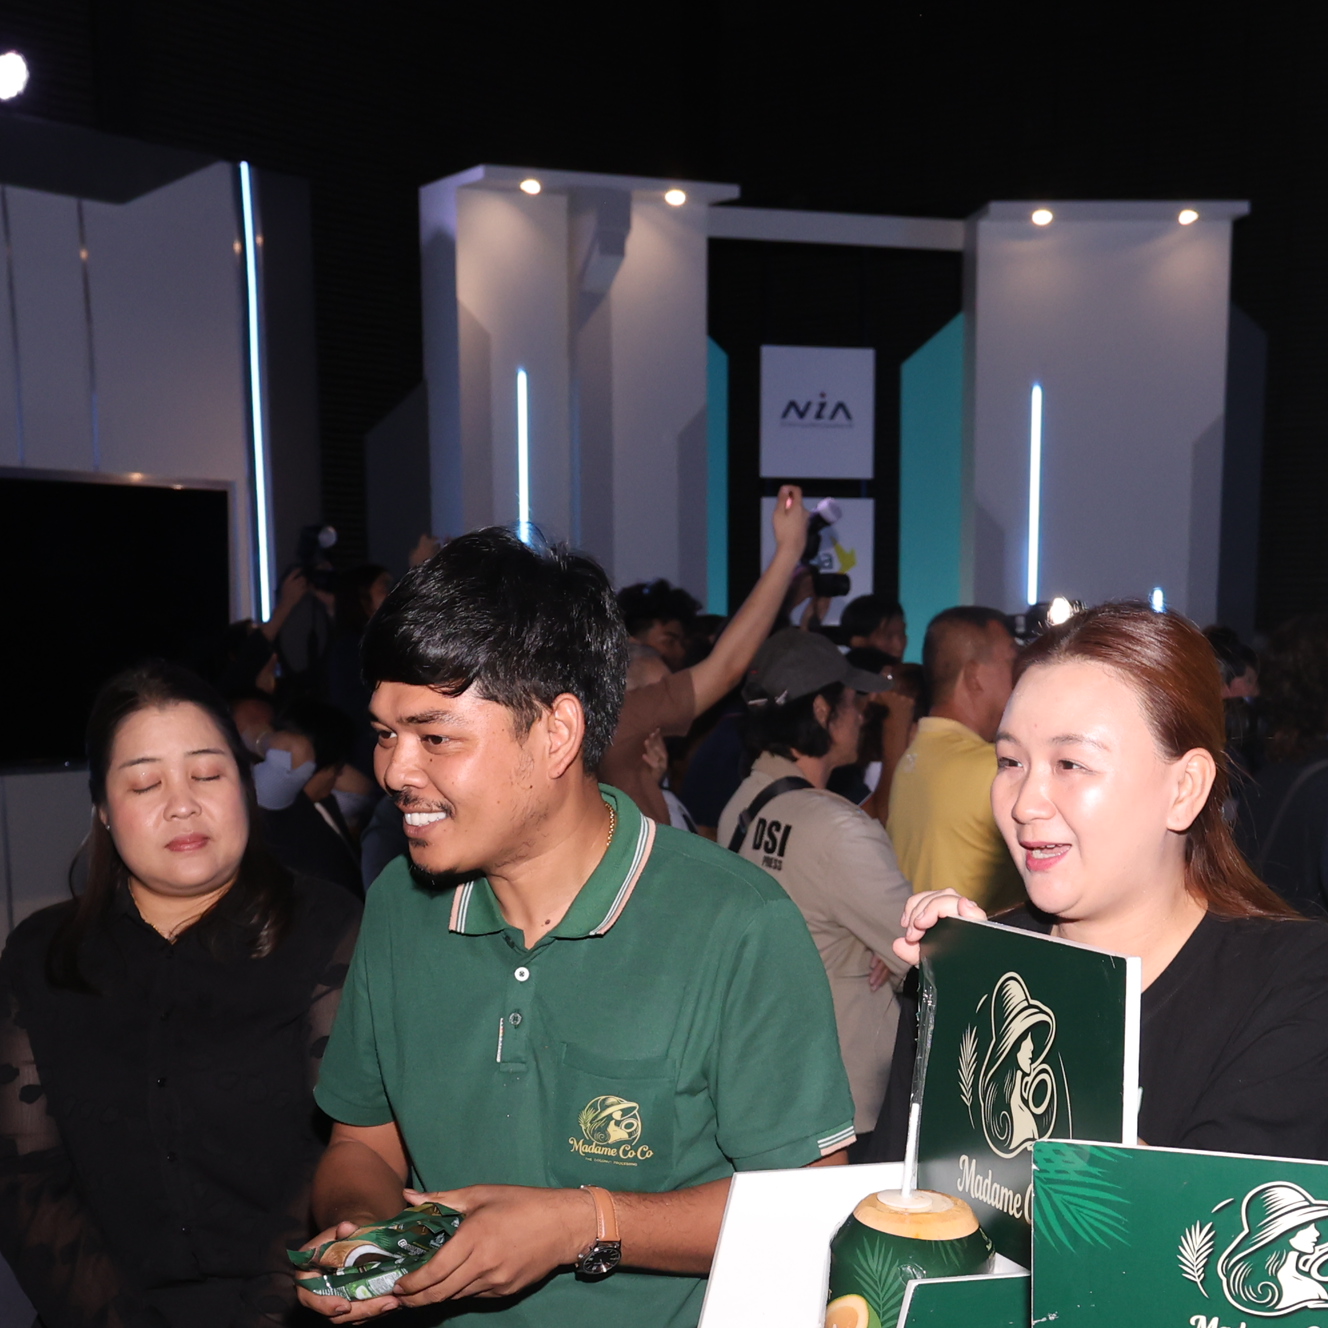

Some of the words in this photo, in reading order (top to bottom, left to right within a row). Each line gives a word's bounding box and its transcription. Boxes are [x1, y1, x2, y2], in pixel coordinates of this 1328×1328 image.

[752, 818, 793, 858] DSI
[568, 1137, 618, 1156] Madame
[619, 1144, 636, 1159] Co
[637, 1145, 653, 1160] Co
[957, 1154, 1023, 1219] Madame
